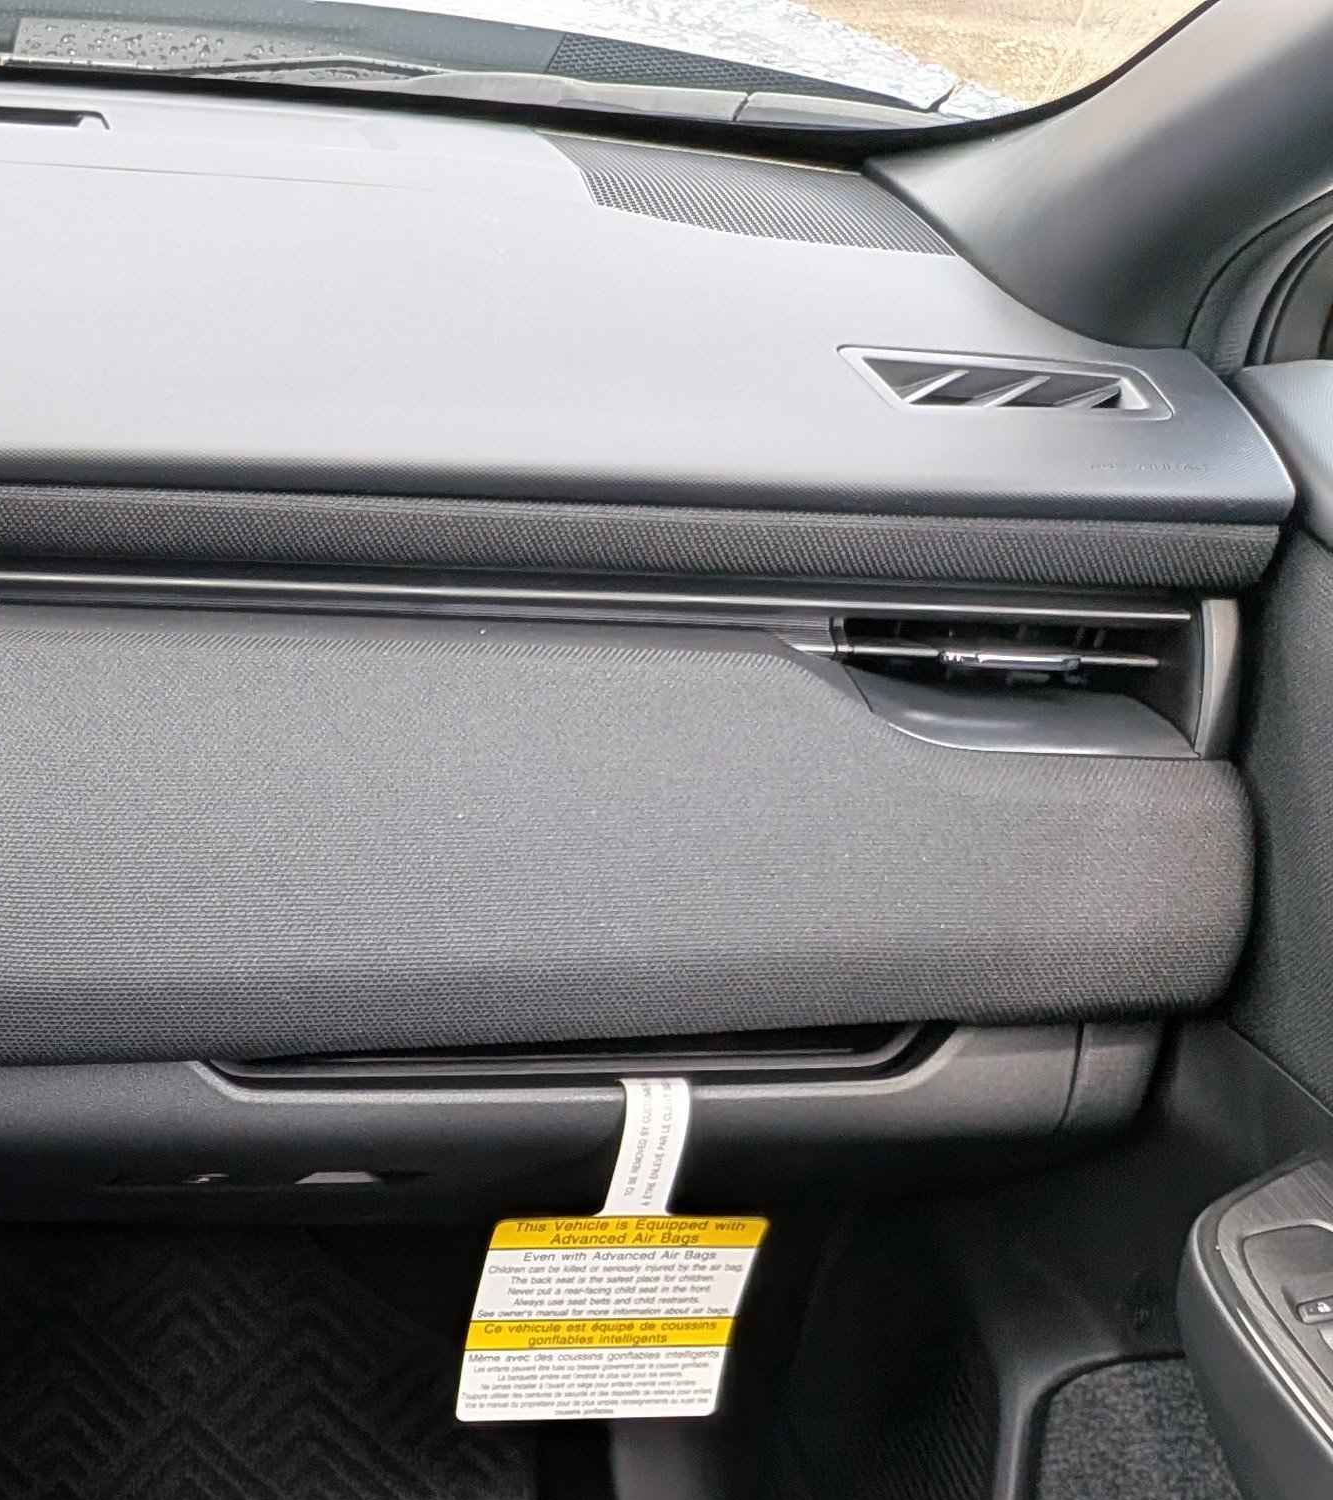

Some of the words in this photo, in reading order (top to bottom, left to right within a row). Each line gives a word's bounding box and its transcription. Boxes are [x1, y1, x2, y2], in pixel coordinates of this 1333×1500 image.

[515, 1221, 546, 1233] This
[555, 1220, 608, 1232] Vehicle
[616, 1220, 628, 1231] is
[635, 1219, 709, 1234] Equipped
[714, 1221, 746, 1232] with
[550, 1232, 626, 1245] Advanced
[632, 1232, 656, 1244] Air
[660, 1232, 699, 1246] Bags
[523, 1251, 556, 1262] Even
[561, 1251, 588, 1262] with
[591, 1250, 656, 1261] Advanced
[661, 1249, 681, 1260] Air
[684, 1249, 717, 1262] Bags
[484, 1322, 502, 1335] Ce
[566, 1321, 586, 1333] est
[639, 1320, 656, 1332] de
[661, 1319, 717, 1331] coussins
